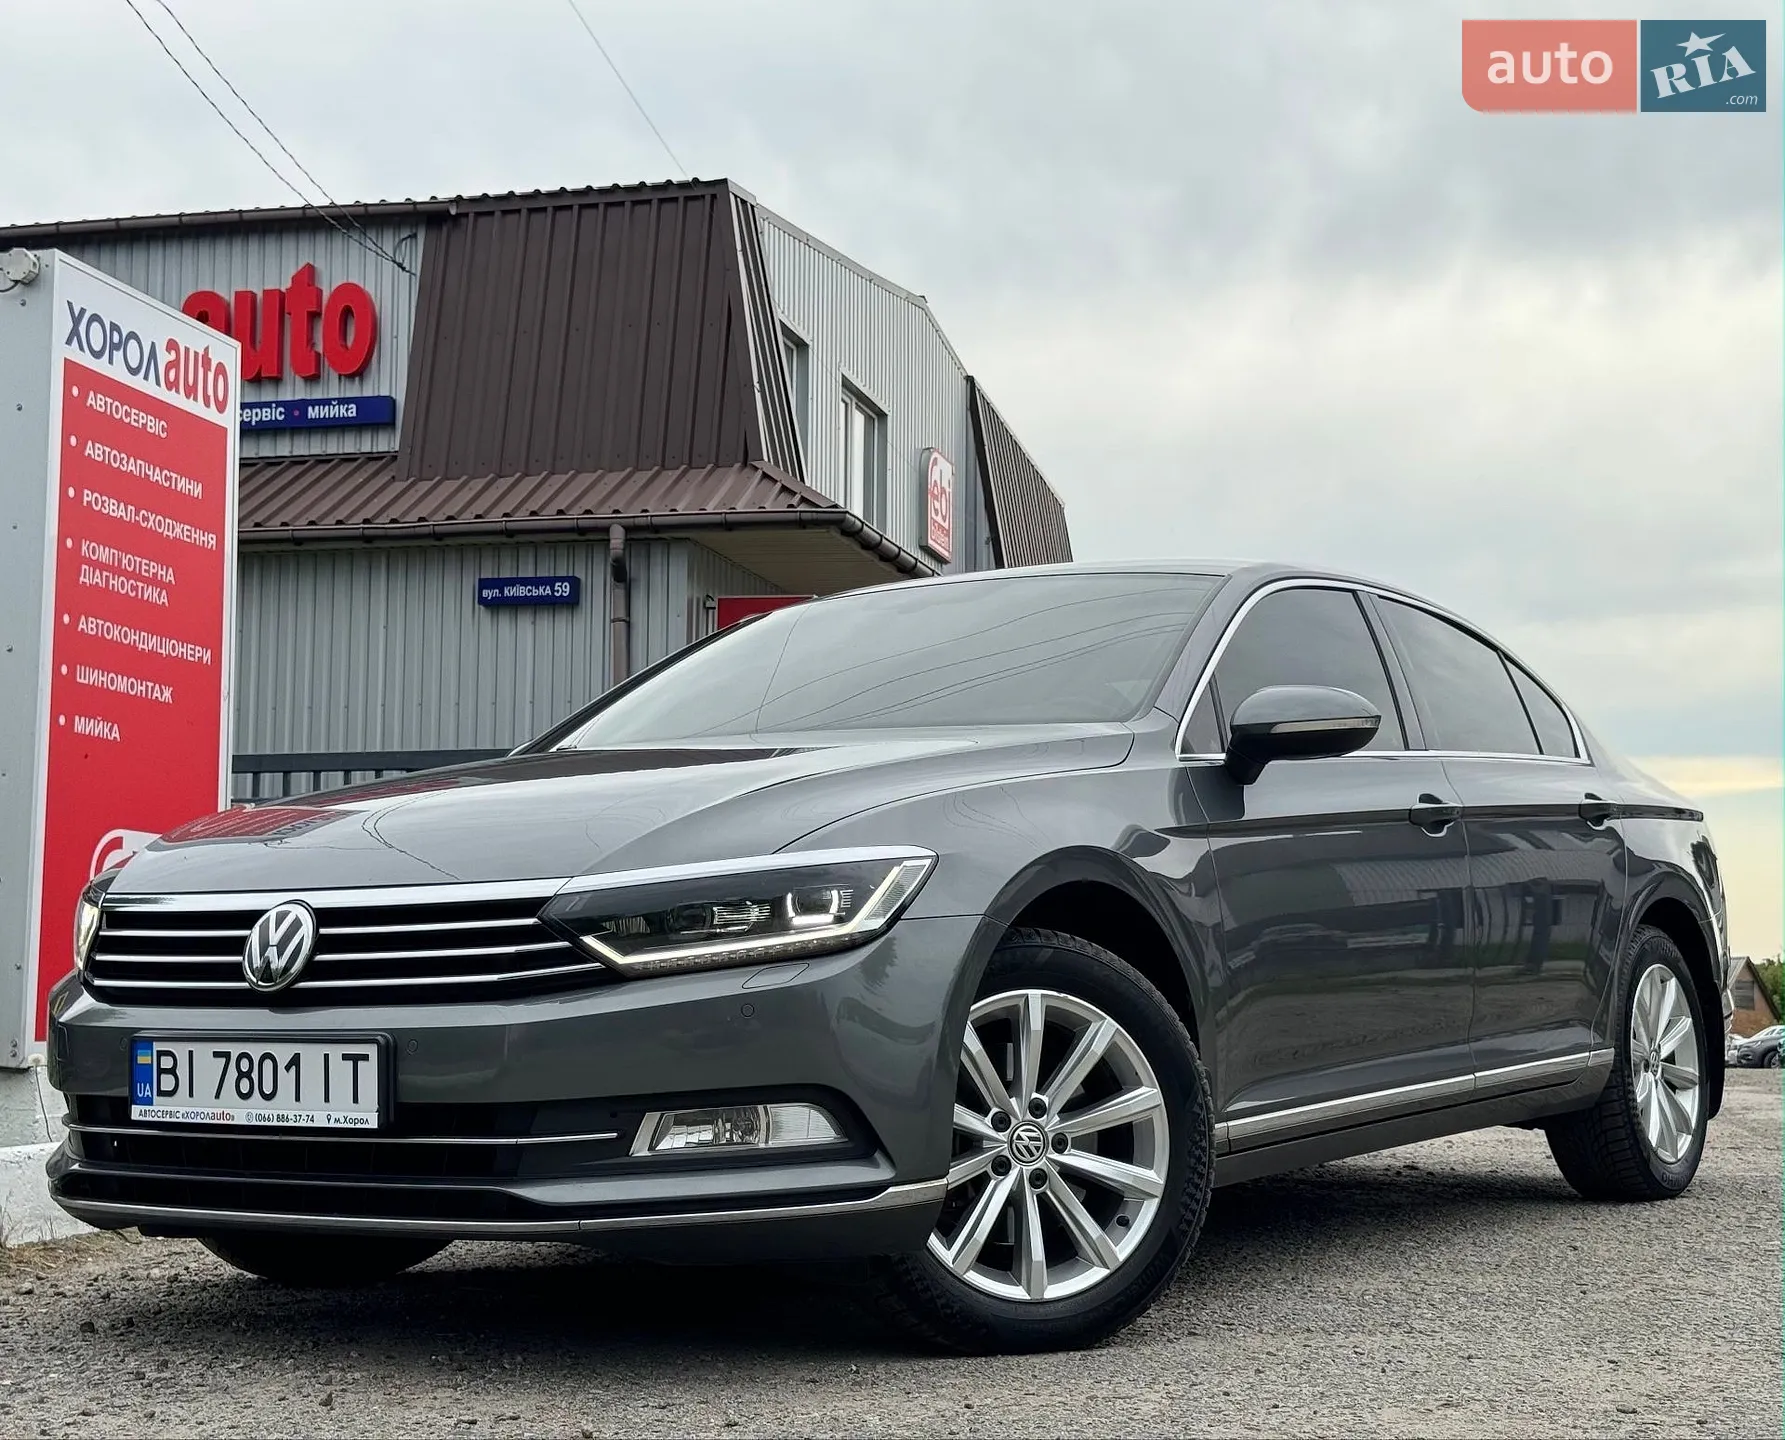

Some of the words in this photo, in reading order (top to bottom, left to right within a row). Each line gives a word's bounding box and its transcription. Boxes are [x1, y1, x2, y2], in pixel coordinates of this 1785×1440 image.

[86, 390, 168, 439] АВТОСЕРВІС
[307, 401, 357, 419] мийка
[84, 440, 203, 500] АВТОЗАПЧАСТИНИ
[82, 489, 217, 550] РОЗВАЛ-СХОДЖЕННЯ
[79, 564, 169, 607] ДІАГНОСТИКА
[482, 588, 502, 600] вул.
[504, 584, 552, 597] КИЇВСЬКА
[554, 582, 570, 597] 59
[77, 615, 212, 666] АВТОКОНДИЦІОНЕРИ
[76, 664, 174, 704] ШИНОМОНТАЖ
[73, 714, 121, 742] МИЙКА
[137, 1083, 152, 1098] UA
[156, 1049, 194, 1098] BI
[212, 1051, 301, 1102] 7801
[323, 1053, 370, 1104] IT
[138, 1109, 180, 1119] АВТОСЕРВІС
[255, 1113, 274, 1123] (066)
[276, 1113, 315, 1124] 886-37-74
